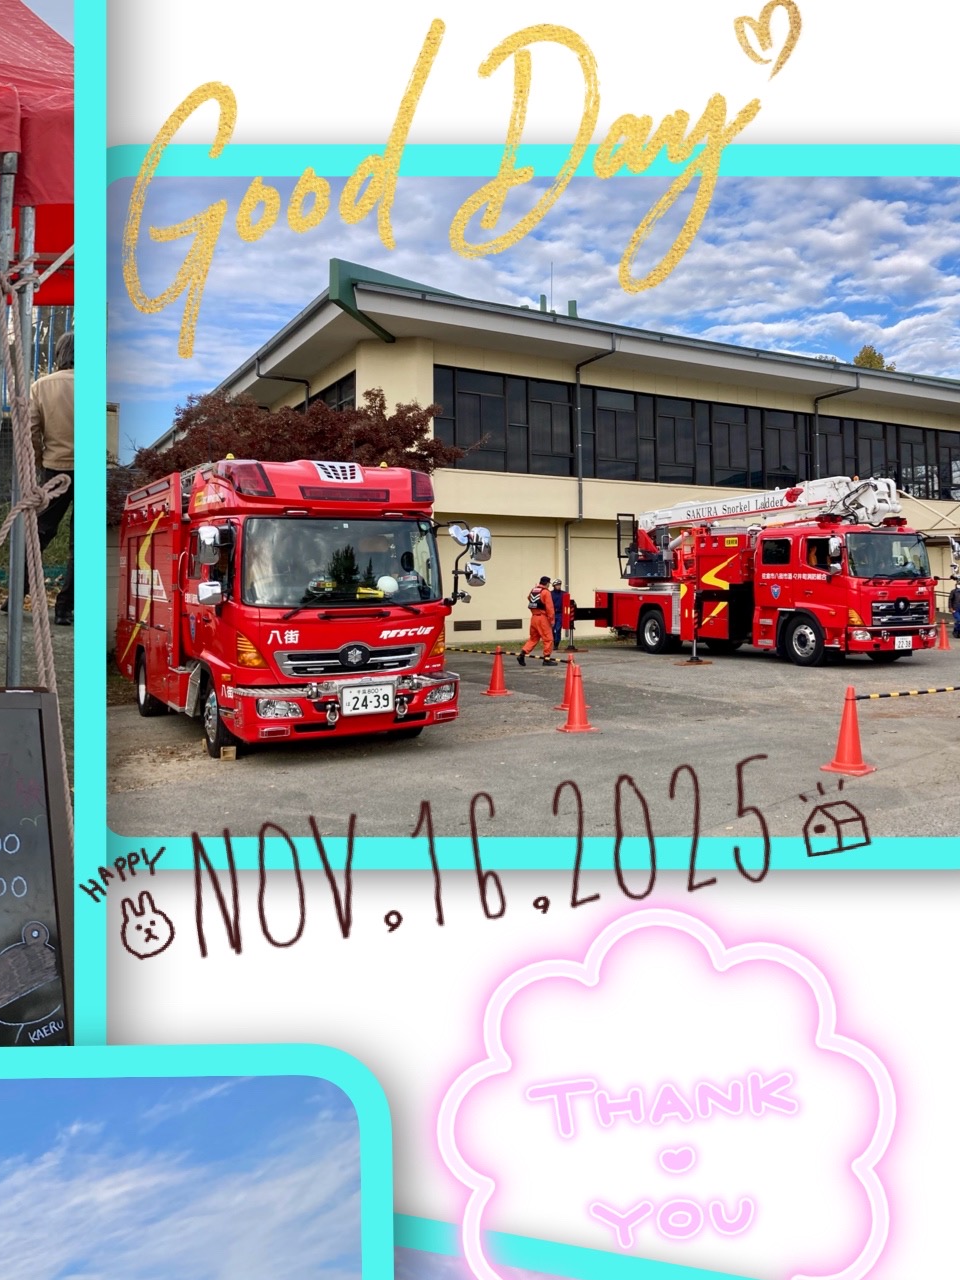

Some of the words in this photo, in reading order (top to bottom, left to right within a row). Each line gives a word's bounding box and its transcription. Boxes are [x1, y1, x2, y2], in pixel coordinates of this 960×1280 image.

[686, 506, 719, 520] SAKURA
[722, 500, 751, 515] Snorkel
[755, 496, 784, 511] Ladder
[267, 630, 300, 645] 八街
[379, 625, 435, 640] RESCUE
[352, 693, 390, 711] 24-39
[28, 1020, 65, 1043] KAERU
